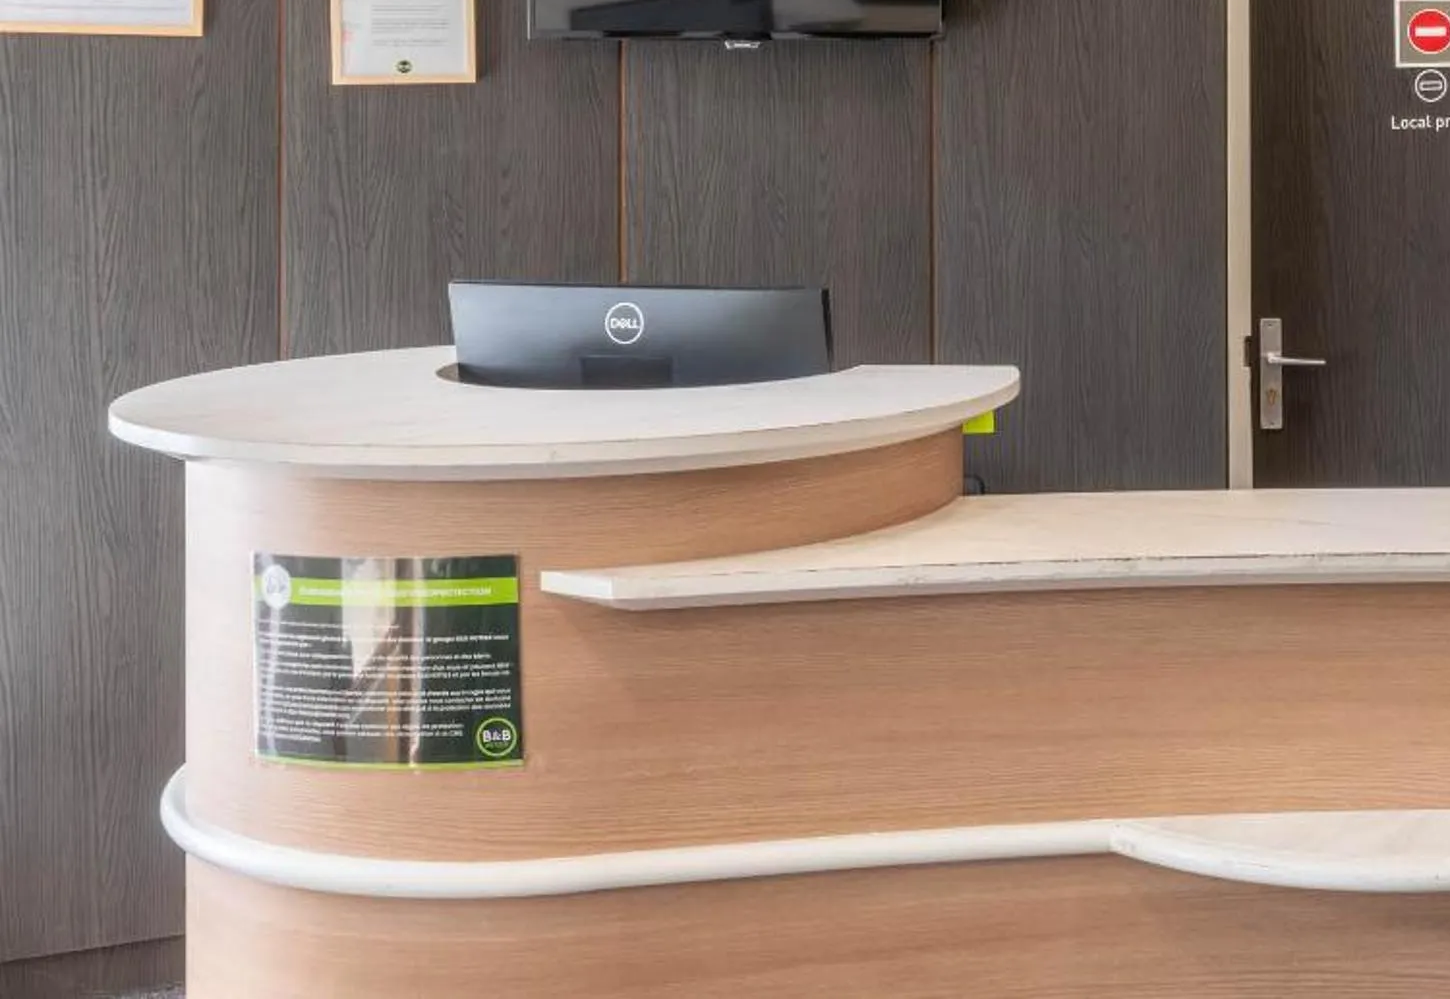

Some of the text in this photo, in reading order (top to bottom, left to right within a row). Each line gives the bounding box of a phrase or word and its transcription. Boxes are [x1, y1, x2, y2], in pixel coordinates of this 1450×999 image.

[1391, 114, 1432, 130] Local
[610, 317, 639, 329] DELL
[482, 729, 512, 743] B&B
